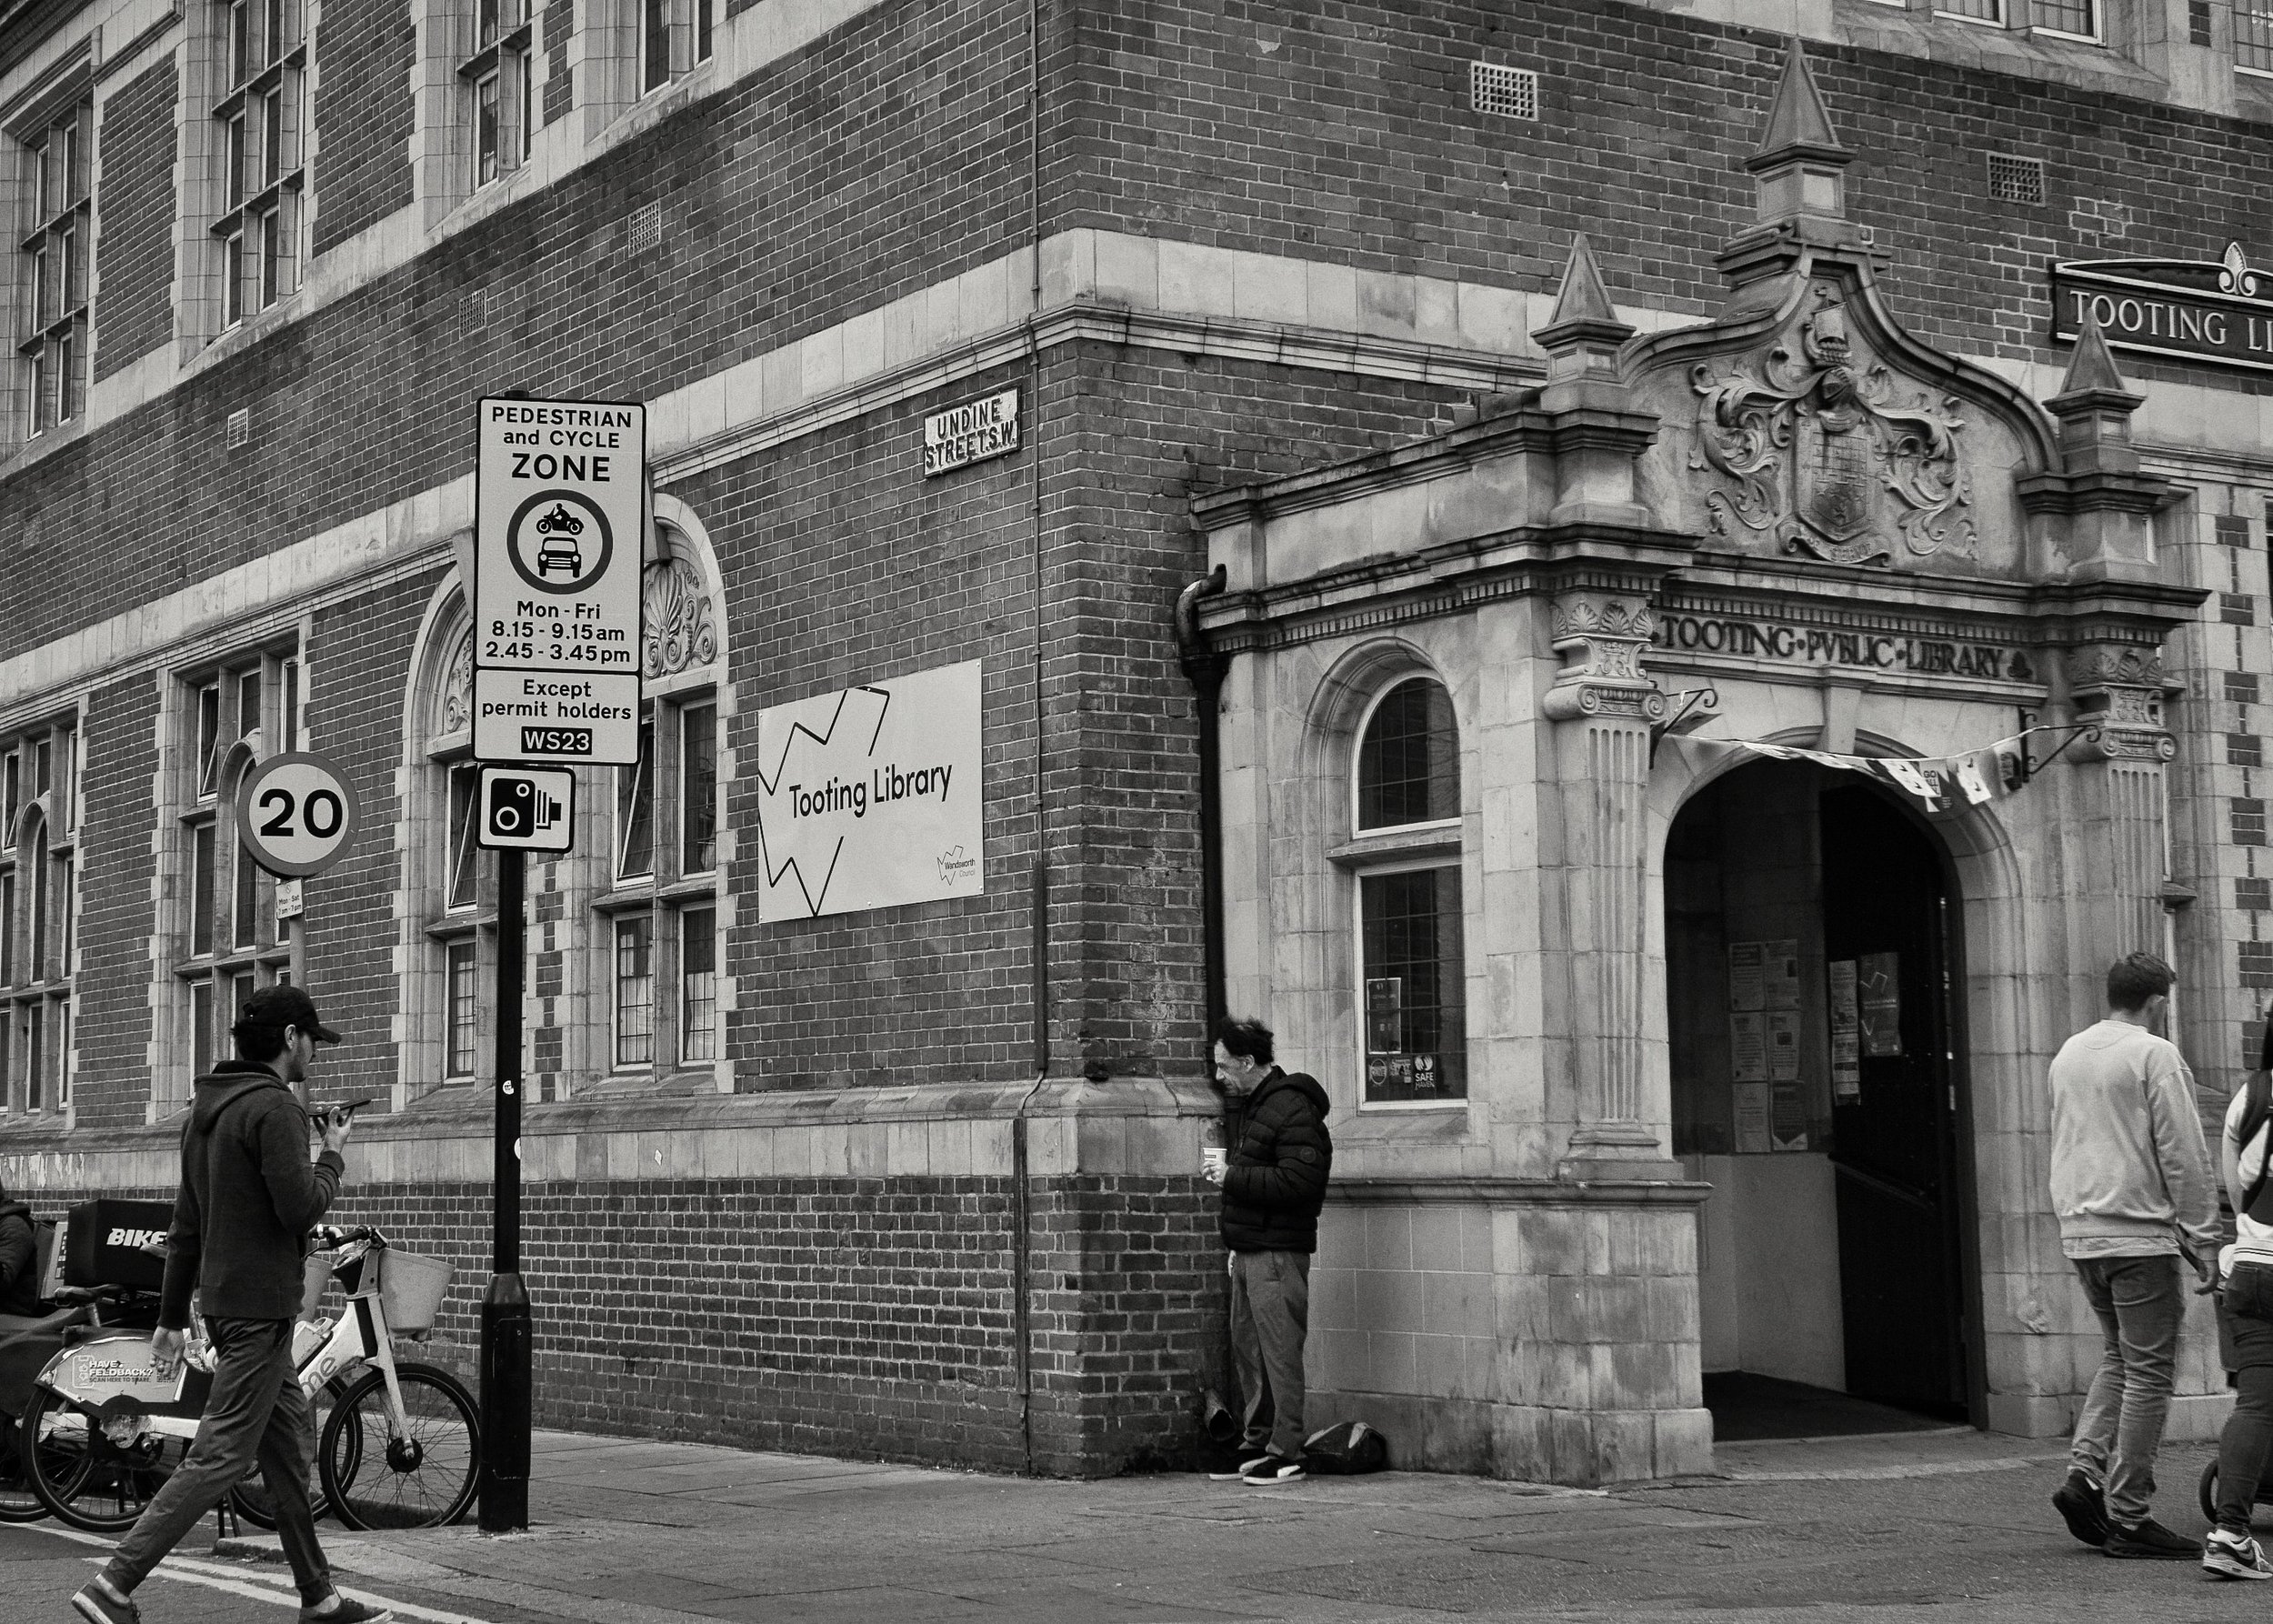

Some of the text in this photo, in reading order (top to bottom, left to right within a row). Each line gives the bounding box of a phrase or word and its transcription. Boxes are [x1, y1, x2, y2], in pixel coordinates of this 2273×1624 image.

[2069, 290, 2227, 345] TOOTING
[492, 406, 631, 427] PEDESTRIAN
[937, 398, 1002, 439] UNDINE
[504, 429, 620, 448] and CYCLE
[512, 453, 610, 482] ZONE
[516, 600, 559, 617] Mon
[575, 603, 601, 619] Fri
[492, 620, 534, 637] 8.15
[486, 641, 534, 658] 2.45
[1660, 615, 1795, 657] TOOTING
[1907, 638, 2004, 677] LIBRARY
[523, 679, 592, 699] Except
[482, 701, 632, 719] permit holders
[525, 730, 590, 751] WS23
[788, 764, 952, 818] Tooting Library
[259, 788, 343, 838] 20
[944, 857, 976, 870] Wandsworth
[1415, 1072, 1434, 1082] SAFE
[106, 1228, 167, 1247] BIKE
